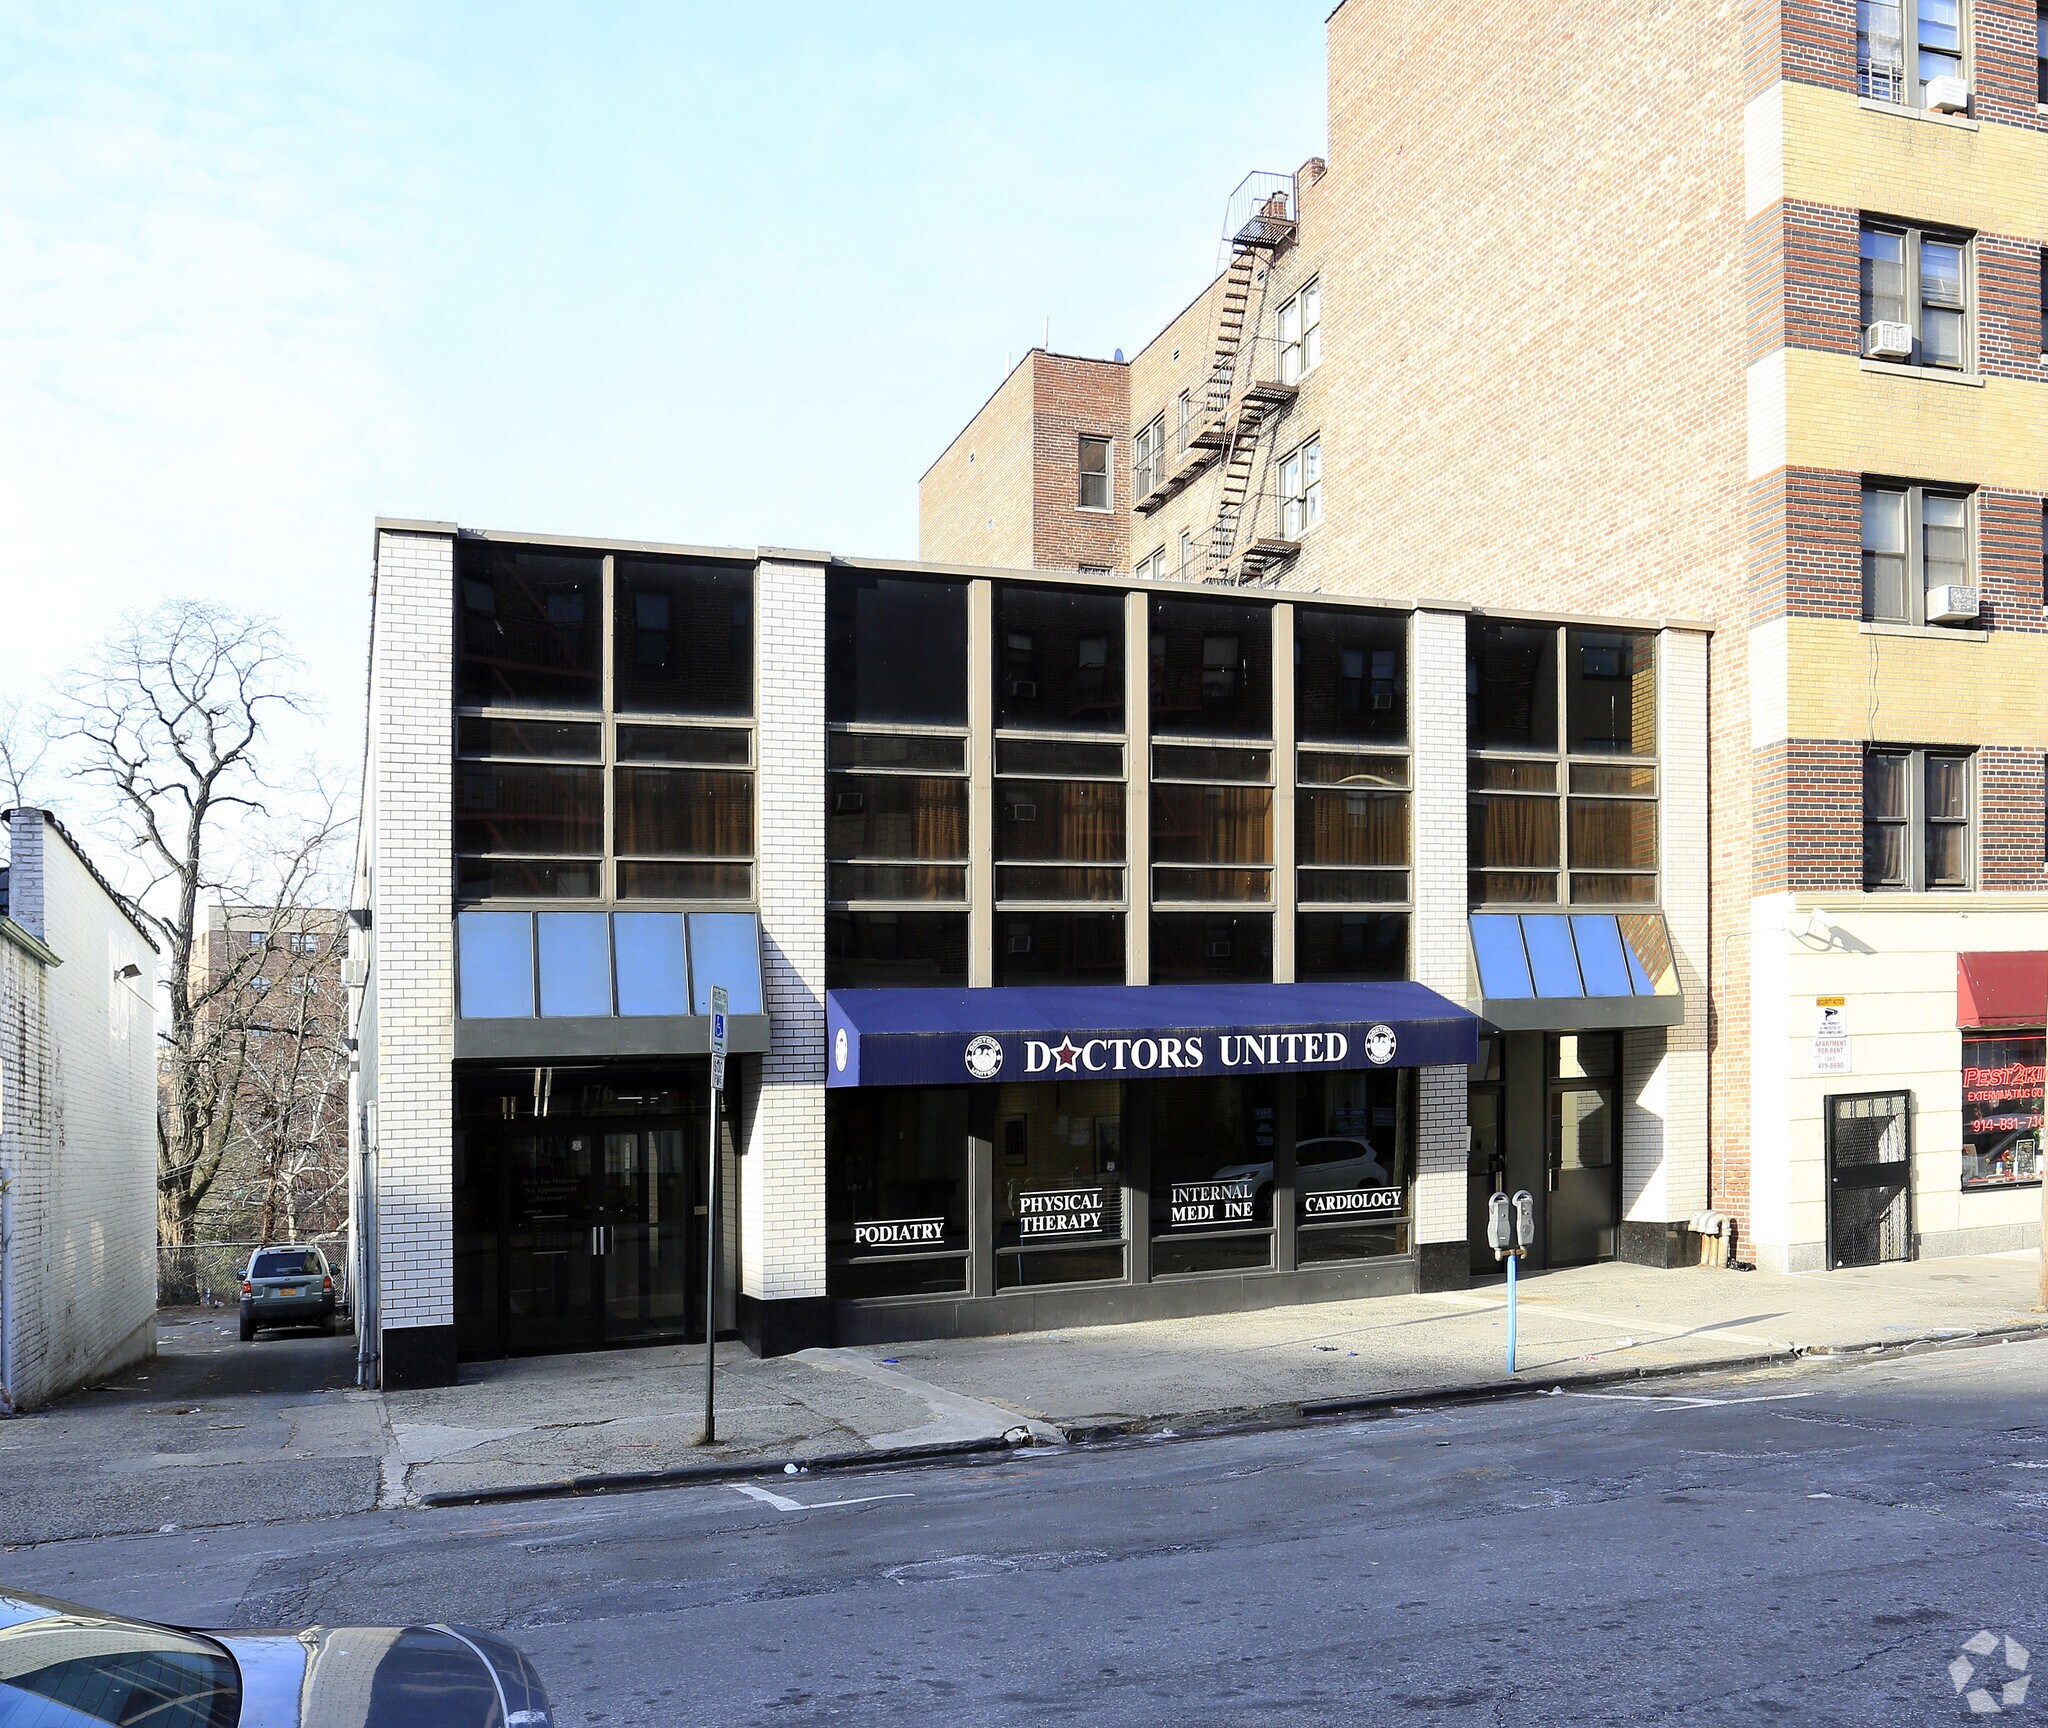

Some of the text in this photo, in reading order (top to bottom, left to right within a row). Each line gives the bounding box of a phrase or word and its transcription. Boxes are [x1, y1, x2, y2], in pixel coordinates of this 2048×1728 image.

[968, 1037, 1000, 1052] DOCTORS
[1218, 1031, 1349, 1067] UNITED
[1815, 1039, 1847, 1047] APARTMENT
[971, 1066, 997, 1077] UNITED
[580, 1083, 614, 1103] 176
[1019, 1193, 1103, 1214] PHYSICAL
[1171, 1184, 1253, 1203] INTERNAL
[1305, 1191, 1402, 1212] CARDIOLOGY
[1020, 1212, 1101, 1232] THERAPY
[854, 1222, 945, 1244] PODIATRY
